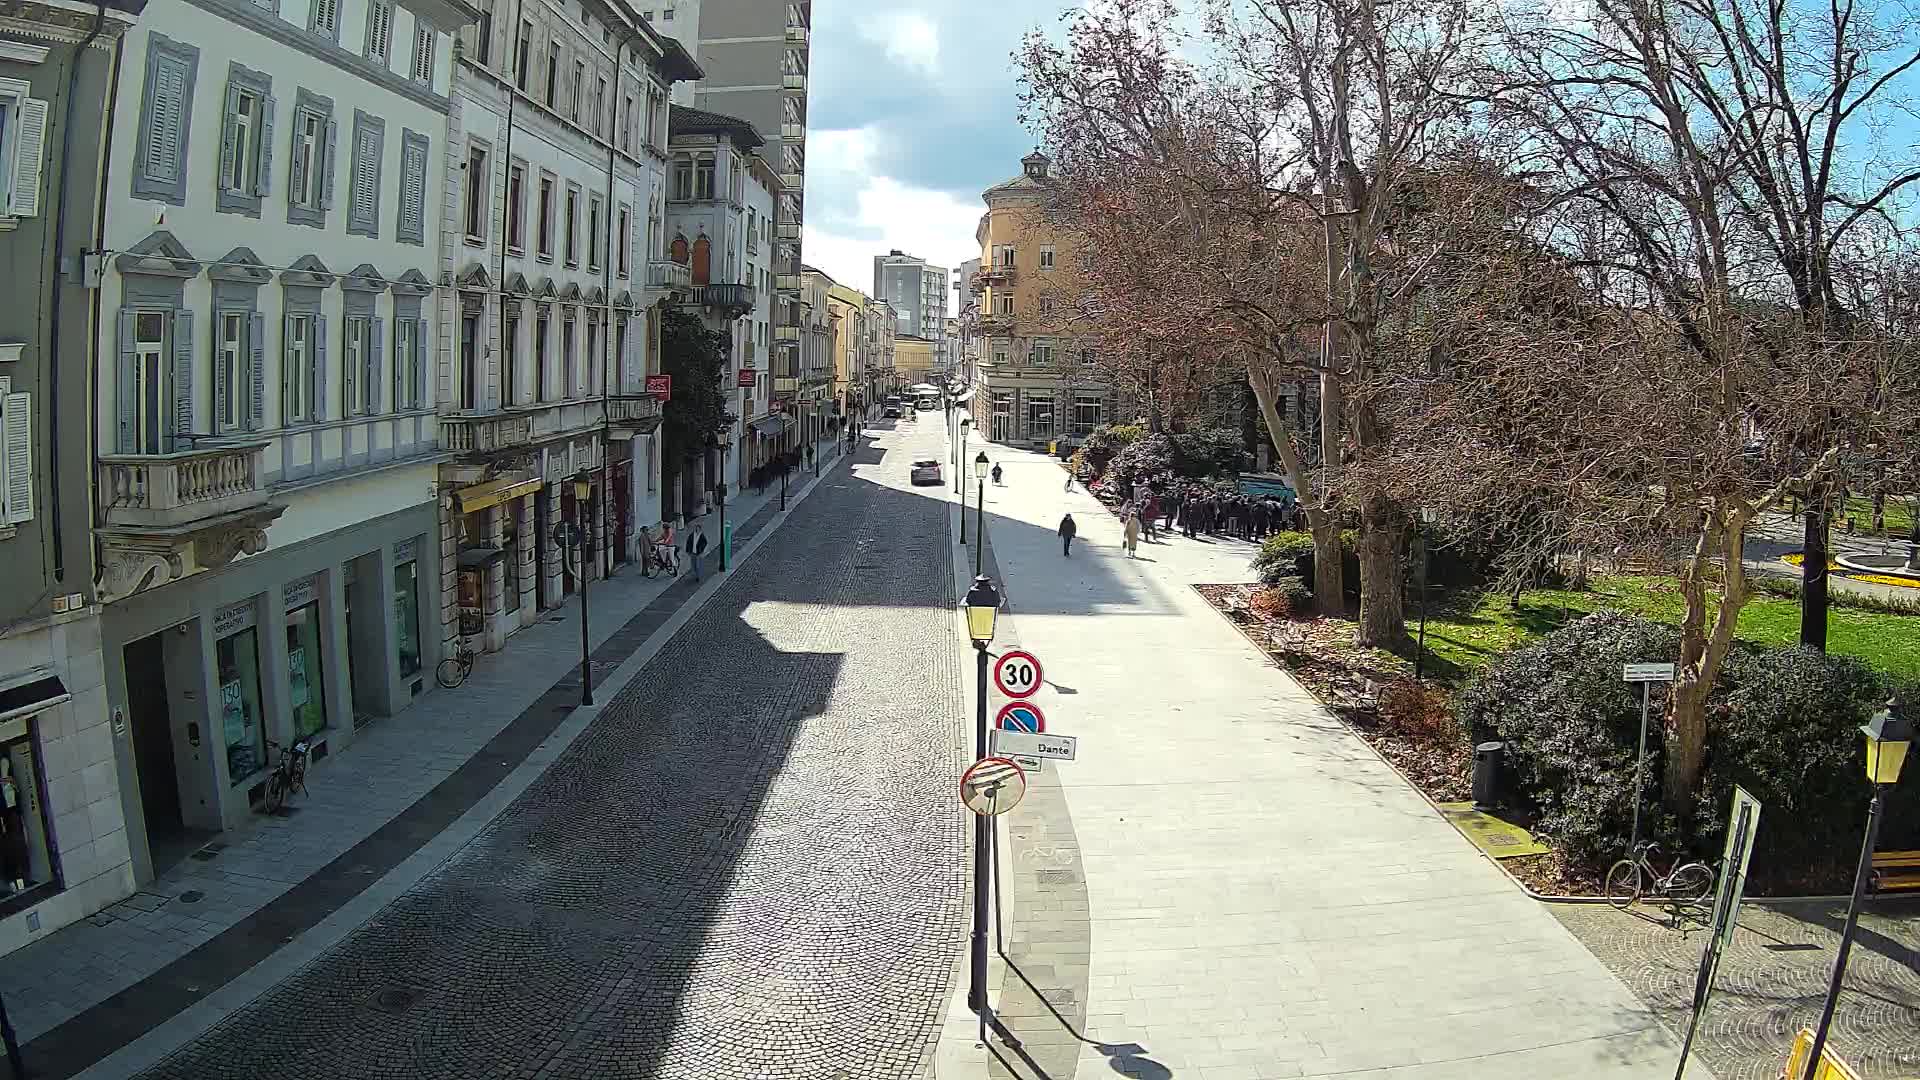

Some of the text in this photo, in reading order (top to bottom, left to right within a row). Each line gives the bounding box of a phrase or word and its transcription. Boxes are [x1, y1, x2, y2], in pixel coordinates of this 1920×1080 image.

[1005, 664, 1033, 685] 30
[223, 682, 240, 704] 130
[1038, 743, 1069, 755] Dante
